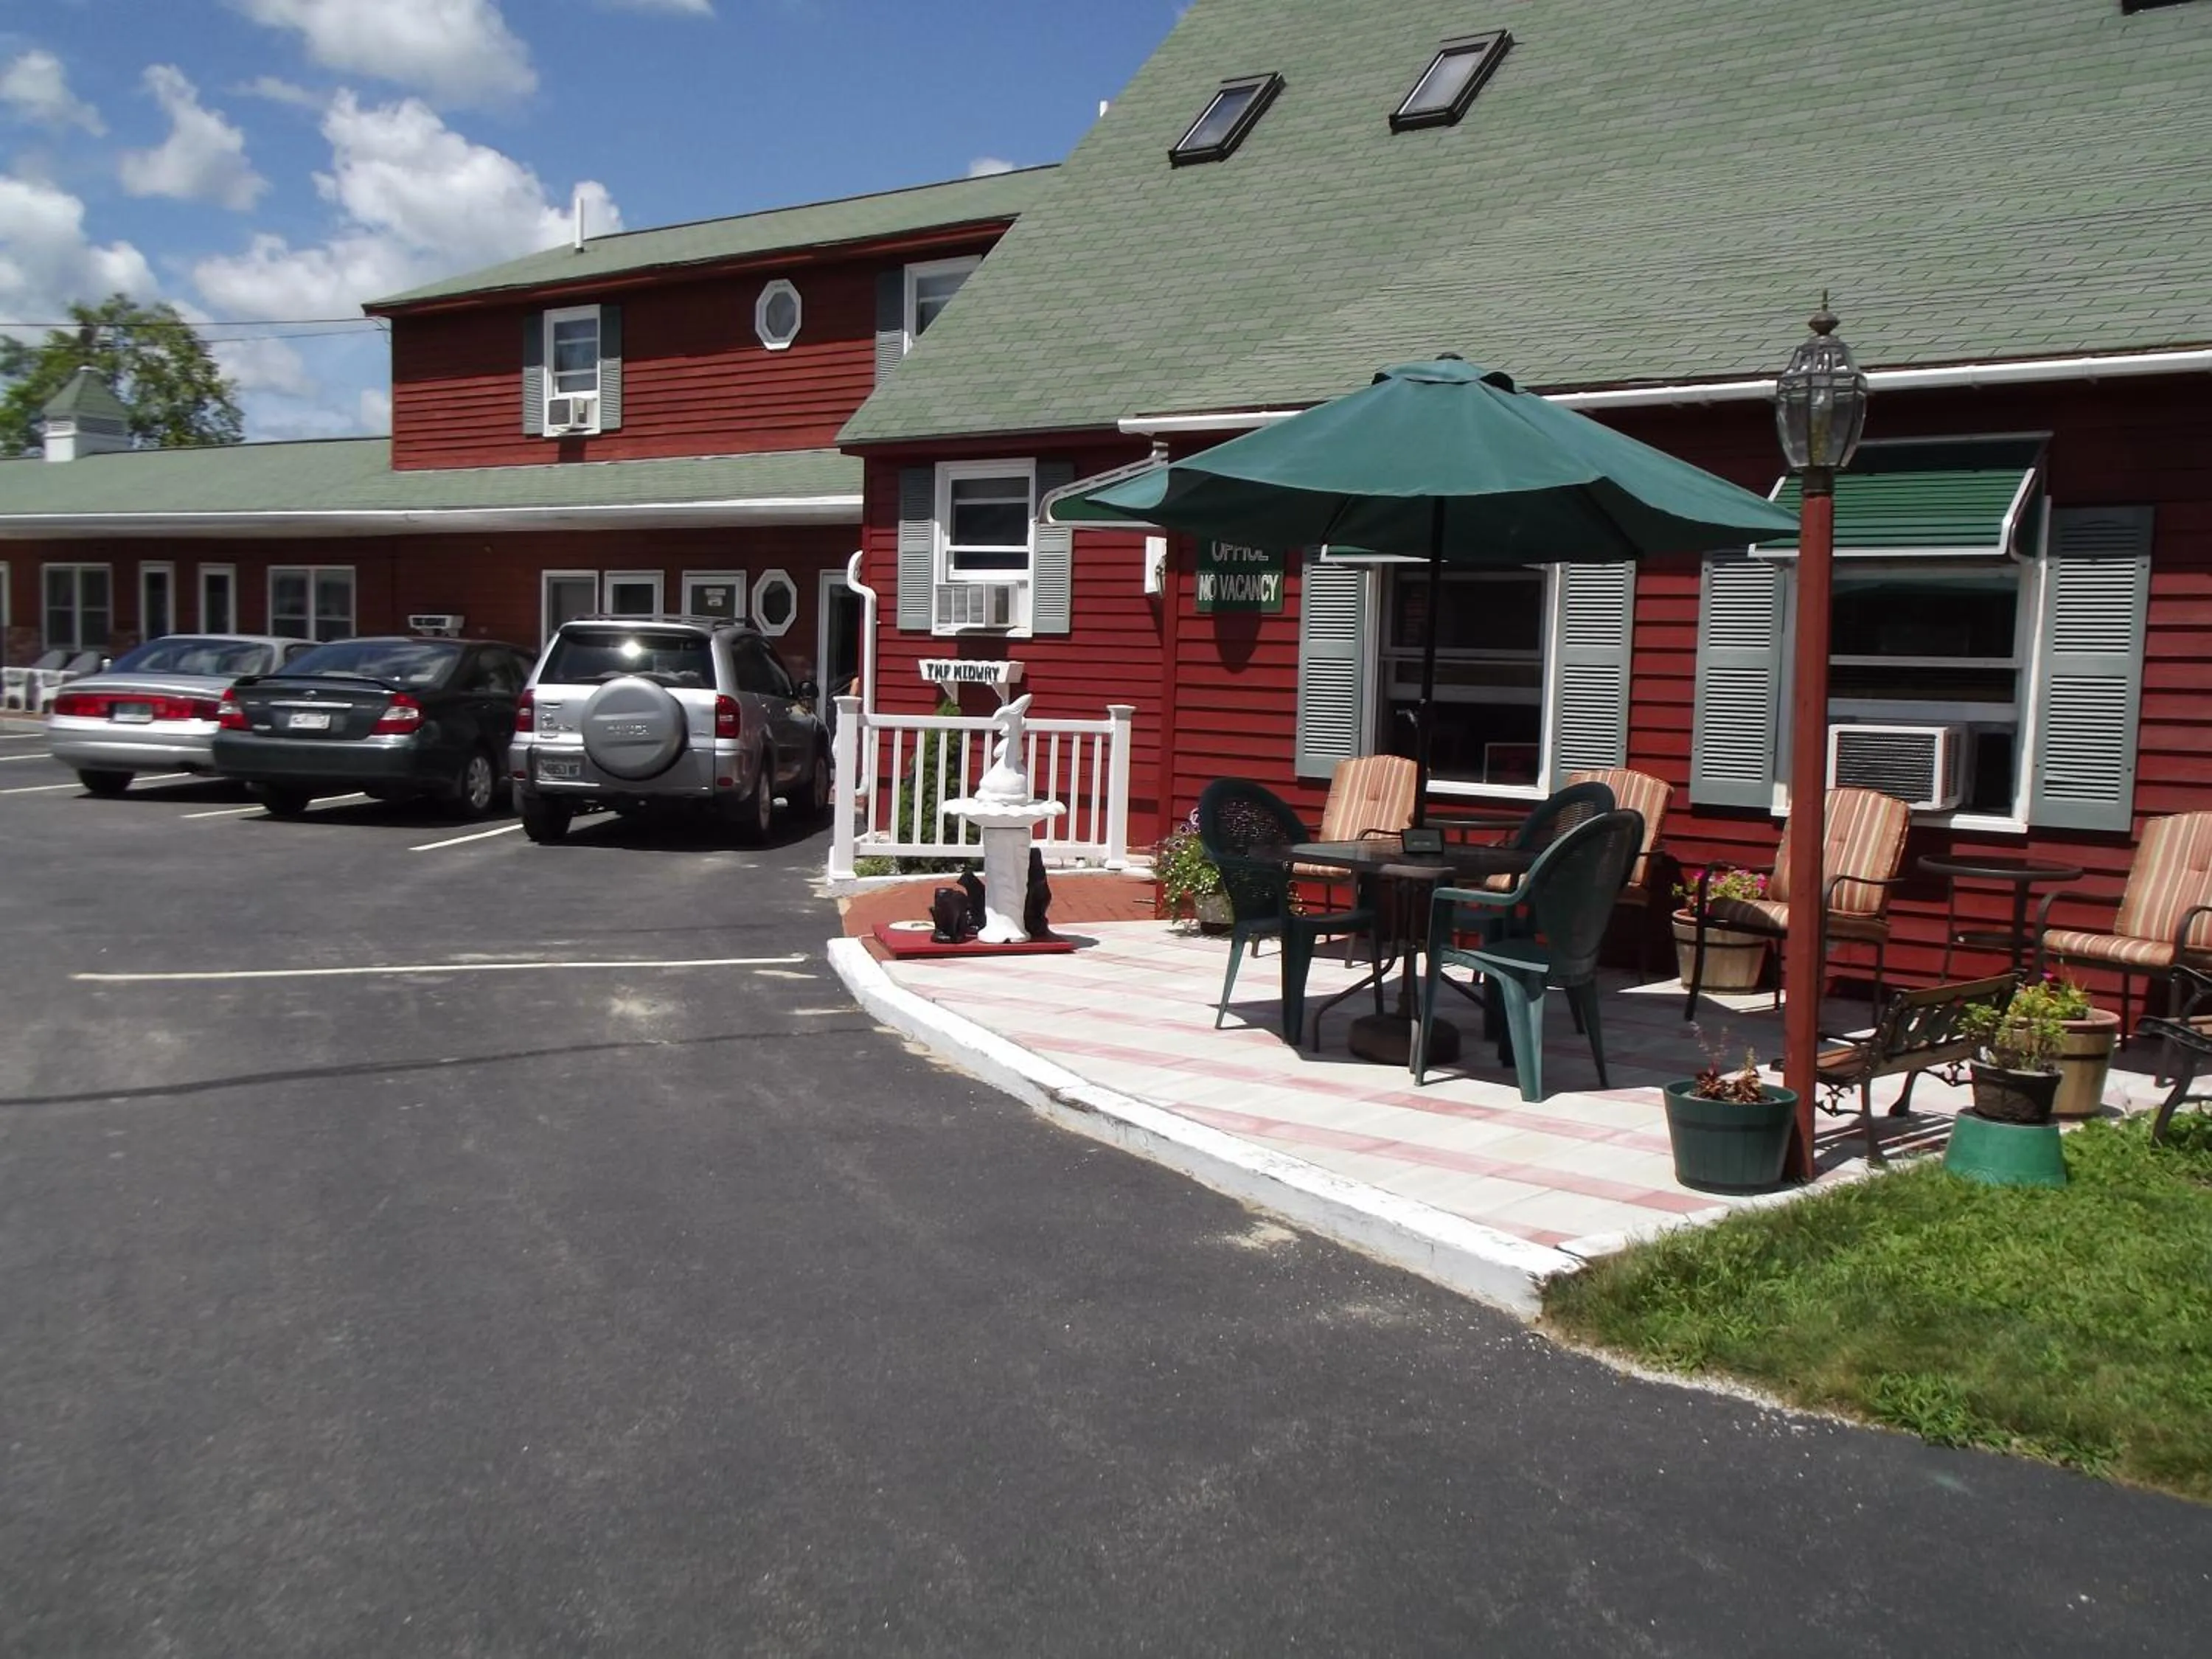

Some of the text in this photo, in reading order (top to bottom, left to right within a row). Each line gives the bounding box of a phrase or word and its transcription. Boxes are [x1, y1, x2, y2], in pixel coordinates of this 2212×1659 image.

[1198, 574, 1279, 602] NO VACANCY
[953, 664, 1001, 681] MIDWAY
